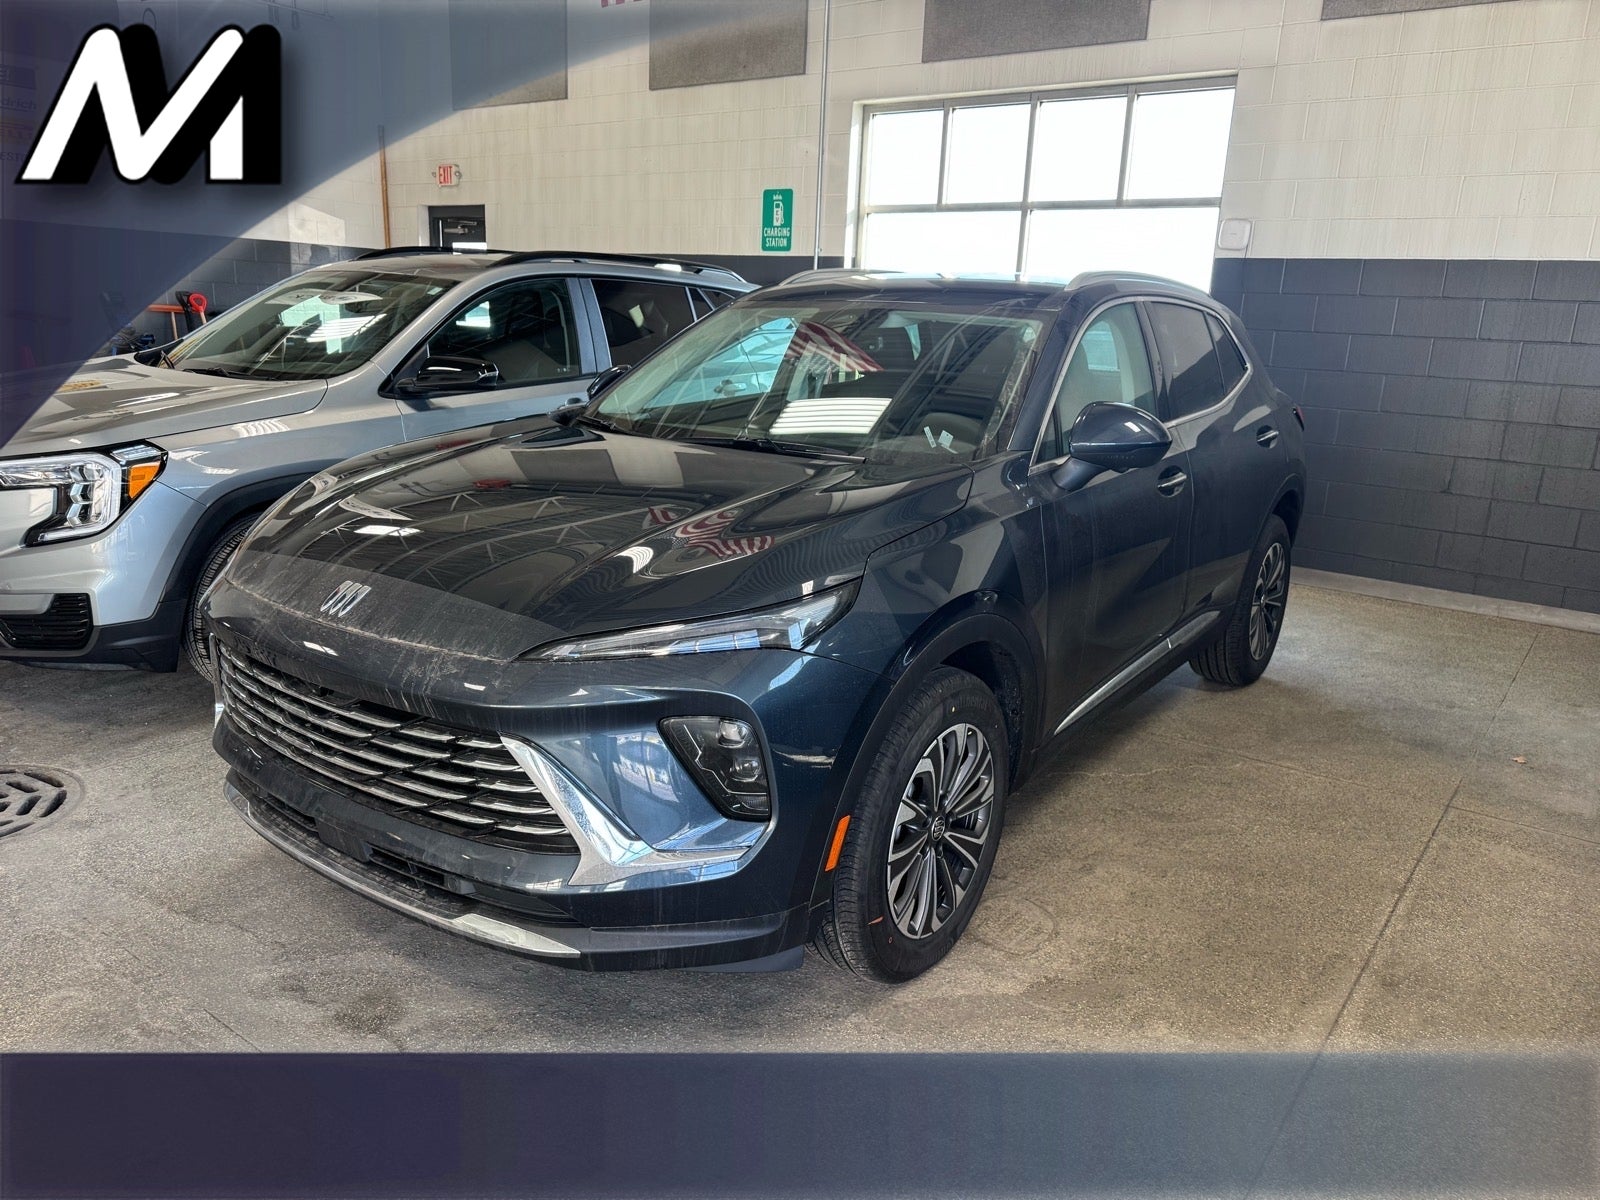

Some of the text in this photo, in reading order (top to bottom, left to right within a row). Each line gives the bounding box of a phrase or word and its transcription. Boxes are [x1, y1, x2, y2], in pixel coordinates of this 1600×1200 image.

[438, 166, 453, 184] EXIT
[764, 227, 790, 237] CHARGING
[765, 237, 788, 247] STATION
